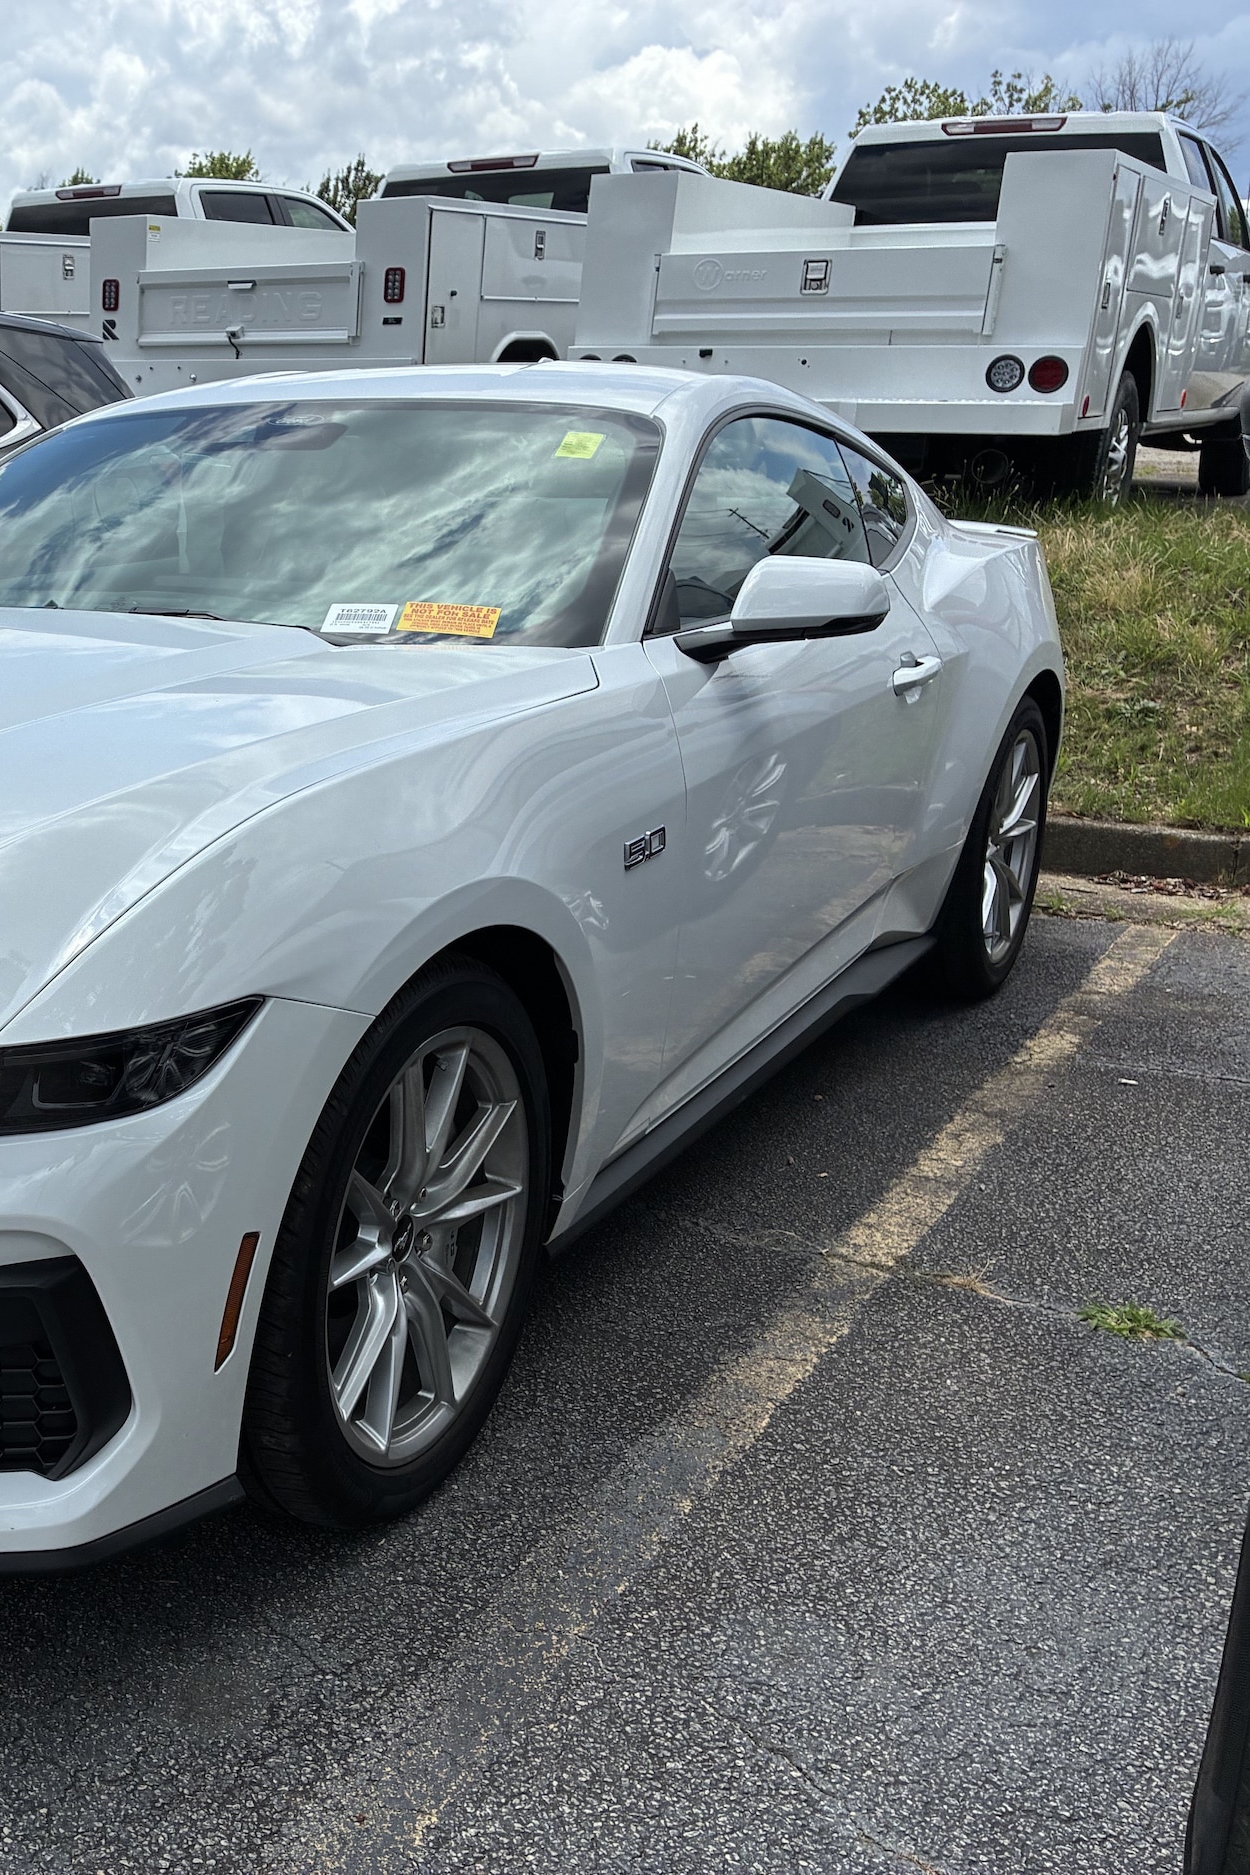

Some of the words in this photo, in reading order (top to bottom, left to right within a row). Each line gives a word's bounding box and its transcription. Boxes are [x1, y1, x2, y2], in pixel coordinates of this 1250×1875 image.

[170, 291, 322, 325] READING
[437, 605, 484, 613] VEHICLE
[624, 824, 666, 871] 5.0
